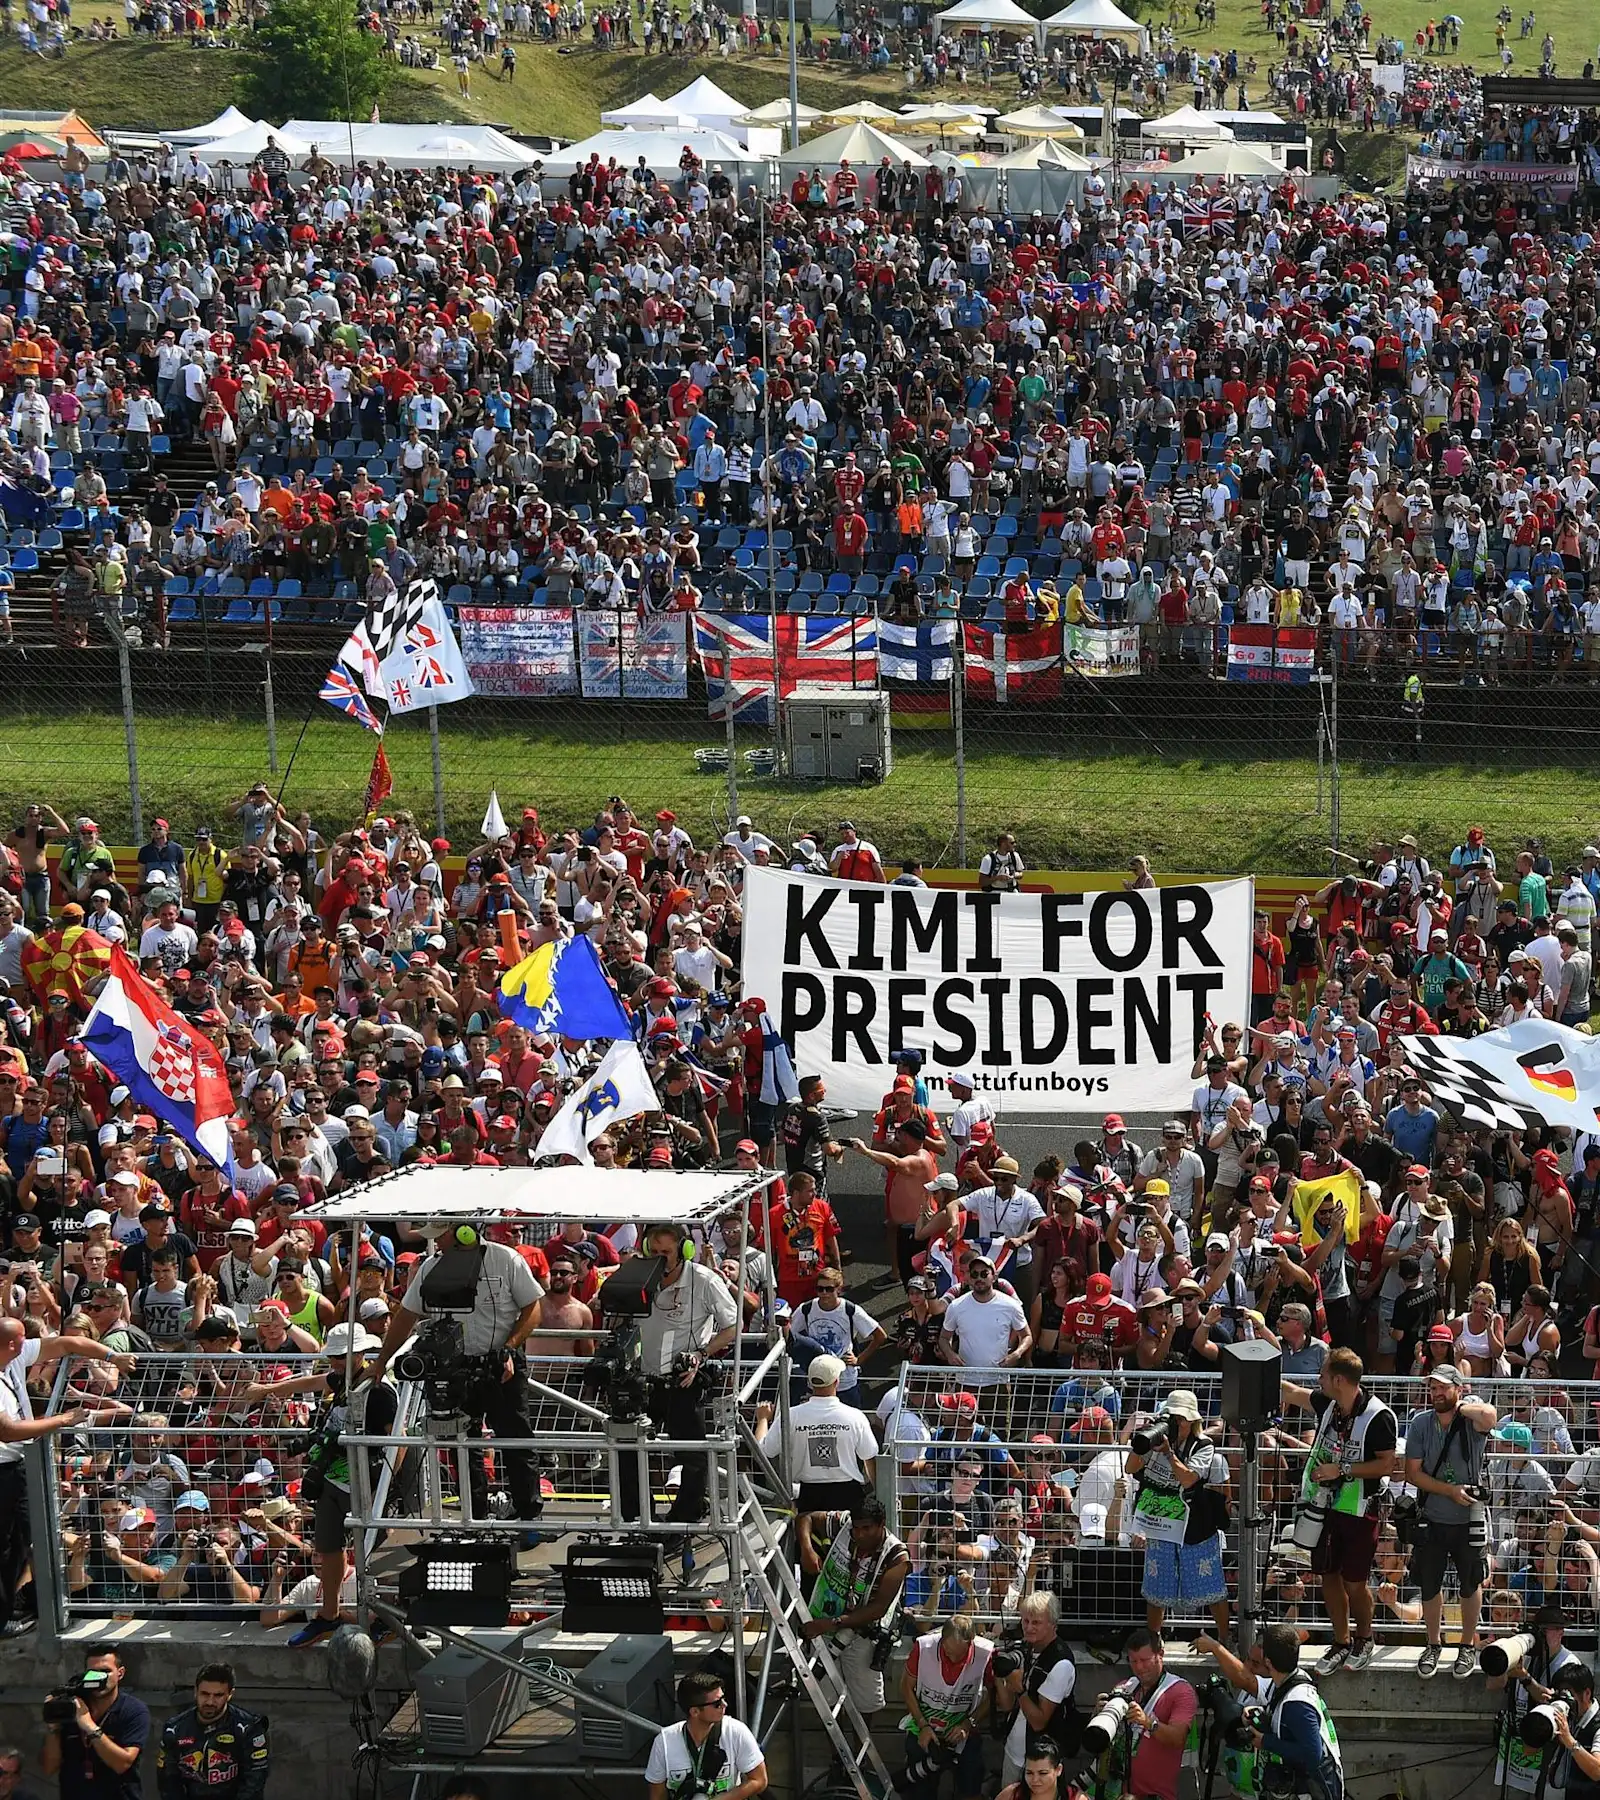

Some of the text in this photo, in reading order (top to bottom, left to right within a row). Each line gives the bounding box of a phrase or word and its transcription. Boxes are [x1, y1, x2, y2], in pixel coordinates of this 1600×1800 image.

[1450, 169, 1485, 180] WRL
[519, 609, 535, 620] UP
[595, 614, 619, 622] HAMME
[1235, 650, 1255, 660] Go
[1283, 653, 1310, 663] Max
[829, 710, 846, 720] RF
[784, 884, 1224, 973] KIMI FOR
[780, 971, 1224, 1068] PRESIDENT
[145, 1305, 180, 1319] NYC
[795, 1423, 850, 1432] HUNGARORING
[208, 1763, 238, 1785] Bull
